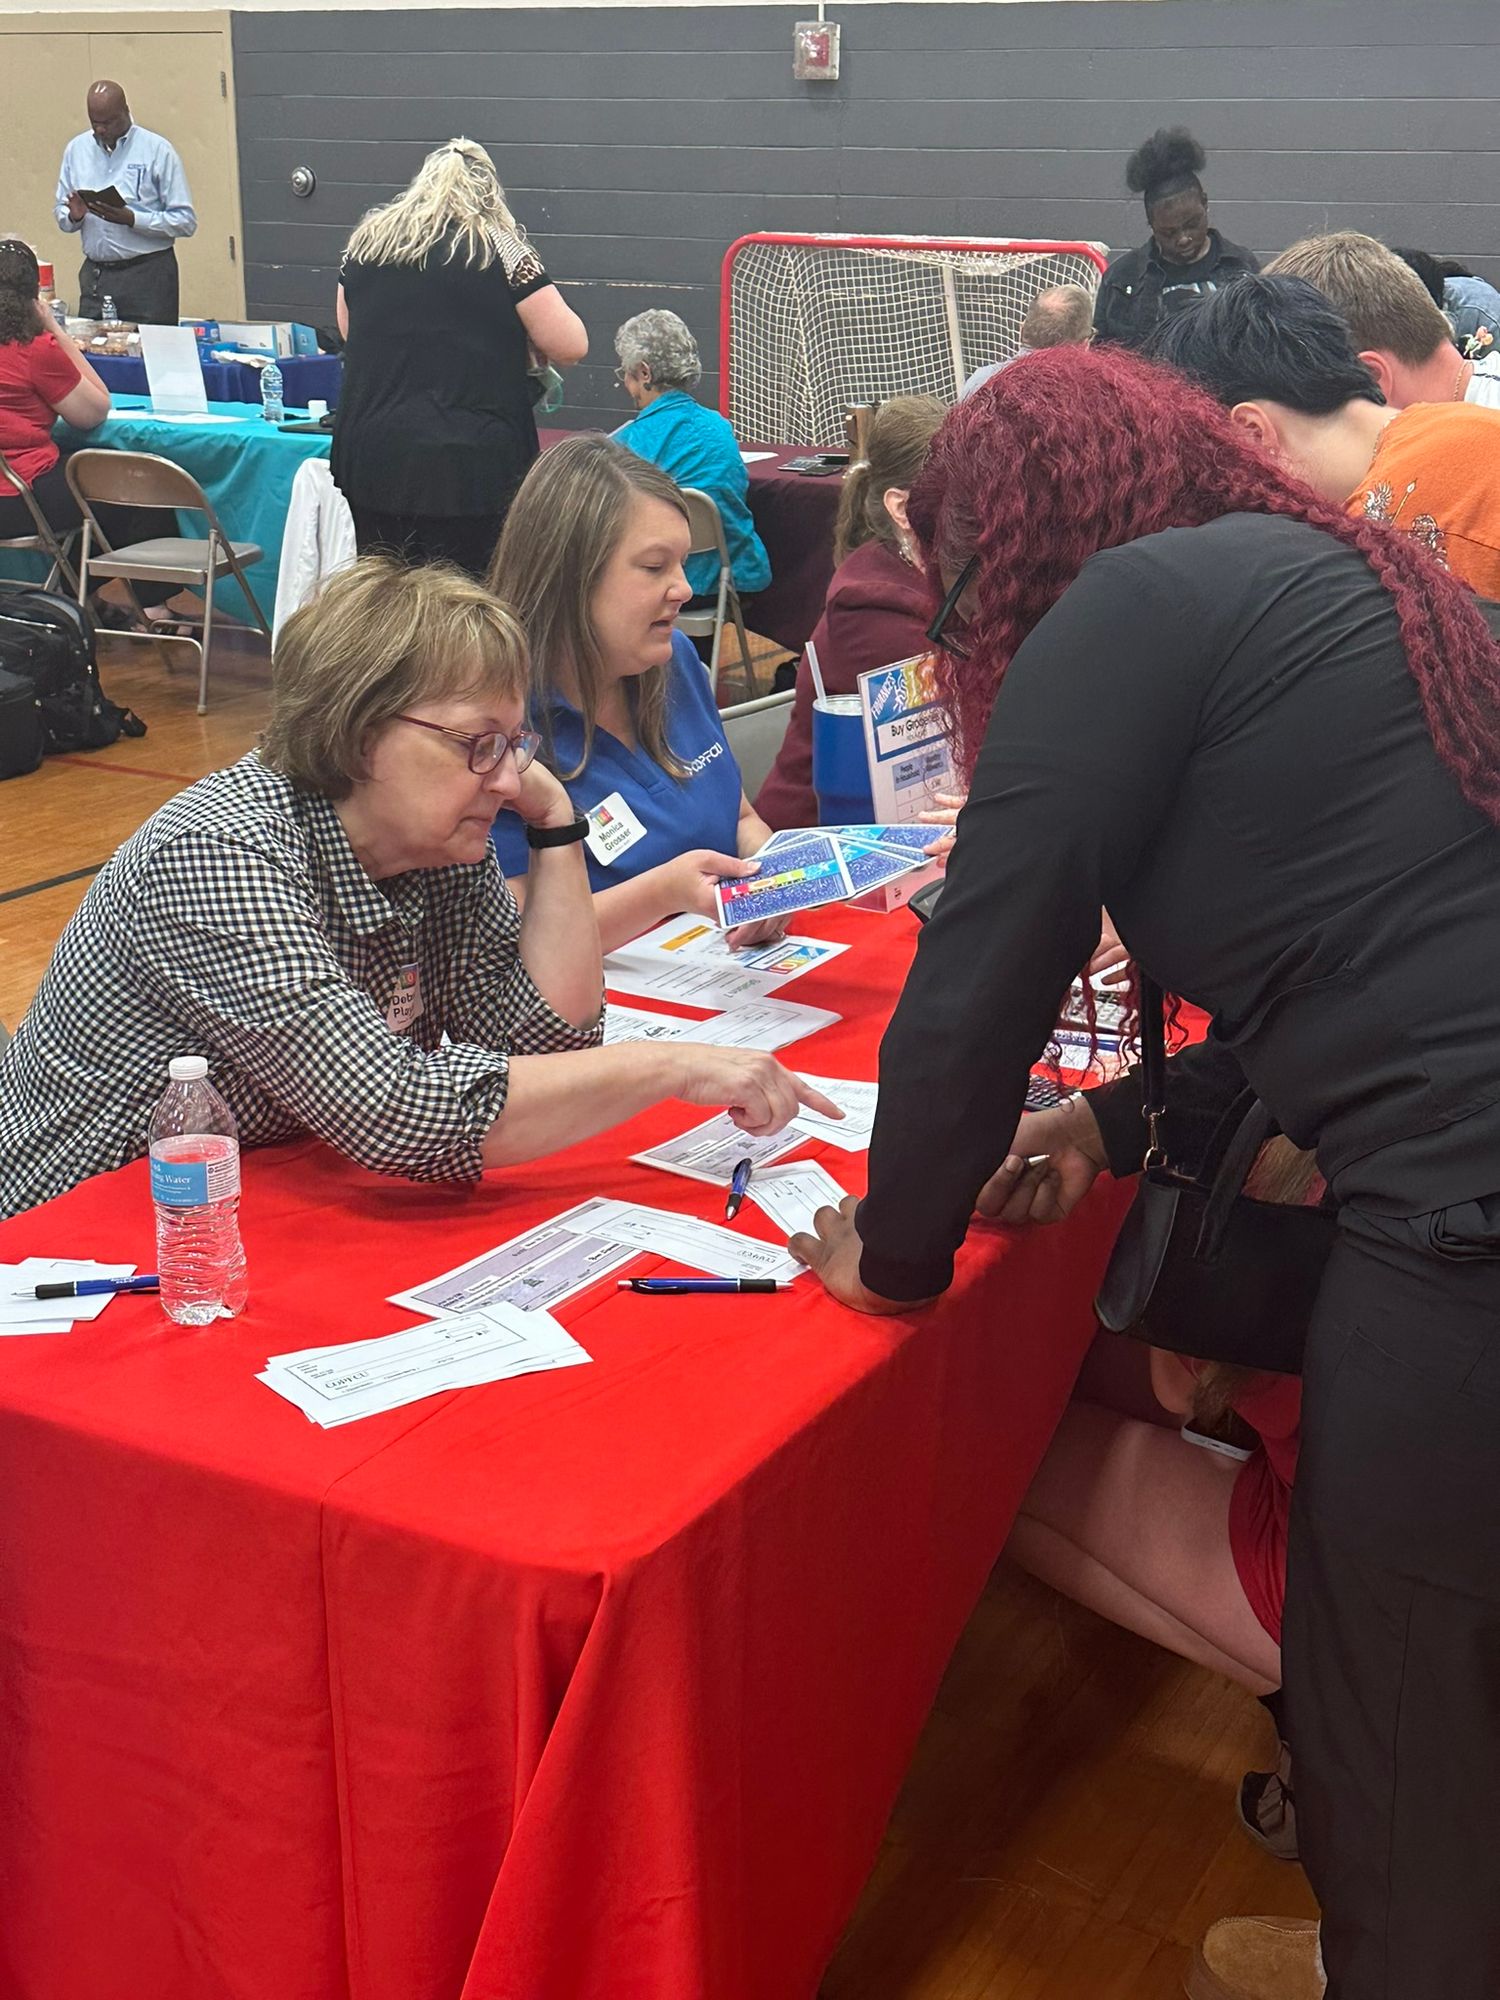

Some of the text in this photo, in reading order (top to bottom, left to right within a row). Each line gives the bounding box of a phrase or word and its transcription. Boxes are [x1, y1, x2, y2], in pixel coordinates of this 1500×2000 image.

[891, 724, 904, 737] Buy
[598, 821, 624, 843] Monica
[604, 828, 631, 851] Grosser
[392, 992, 416, 1006] Deb
[165, 1174, 191, 1184] Water
